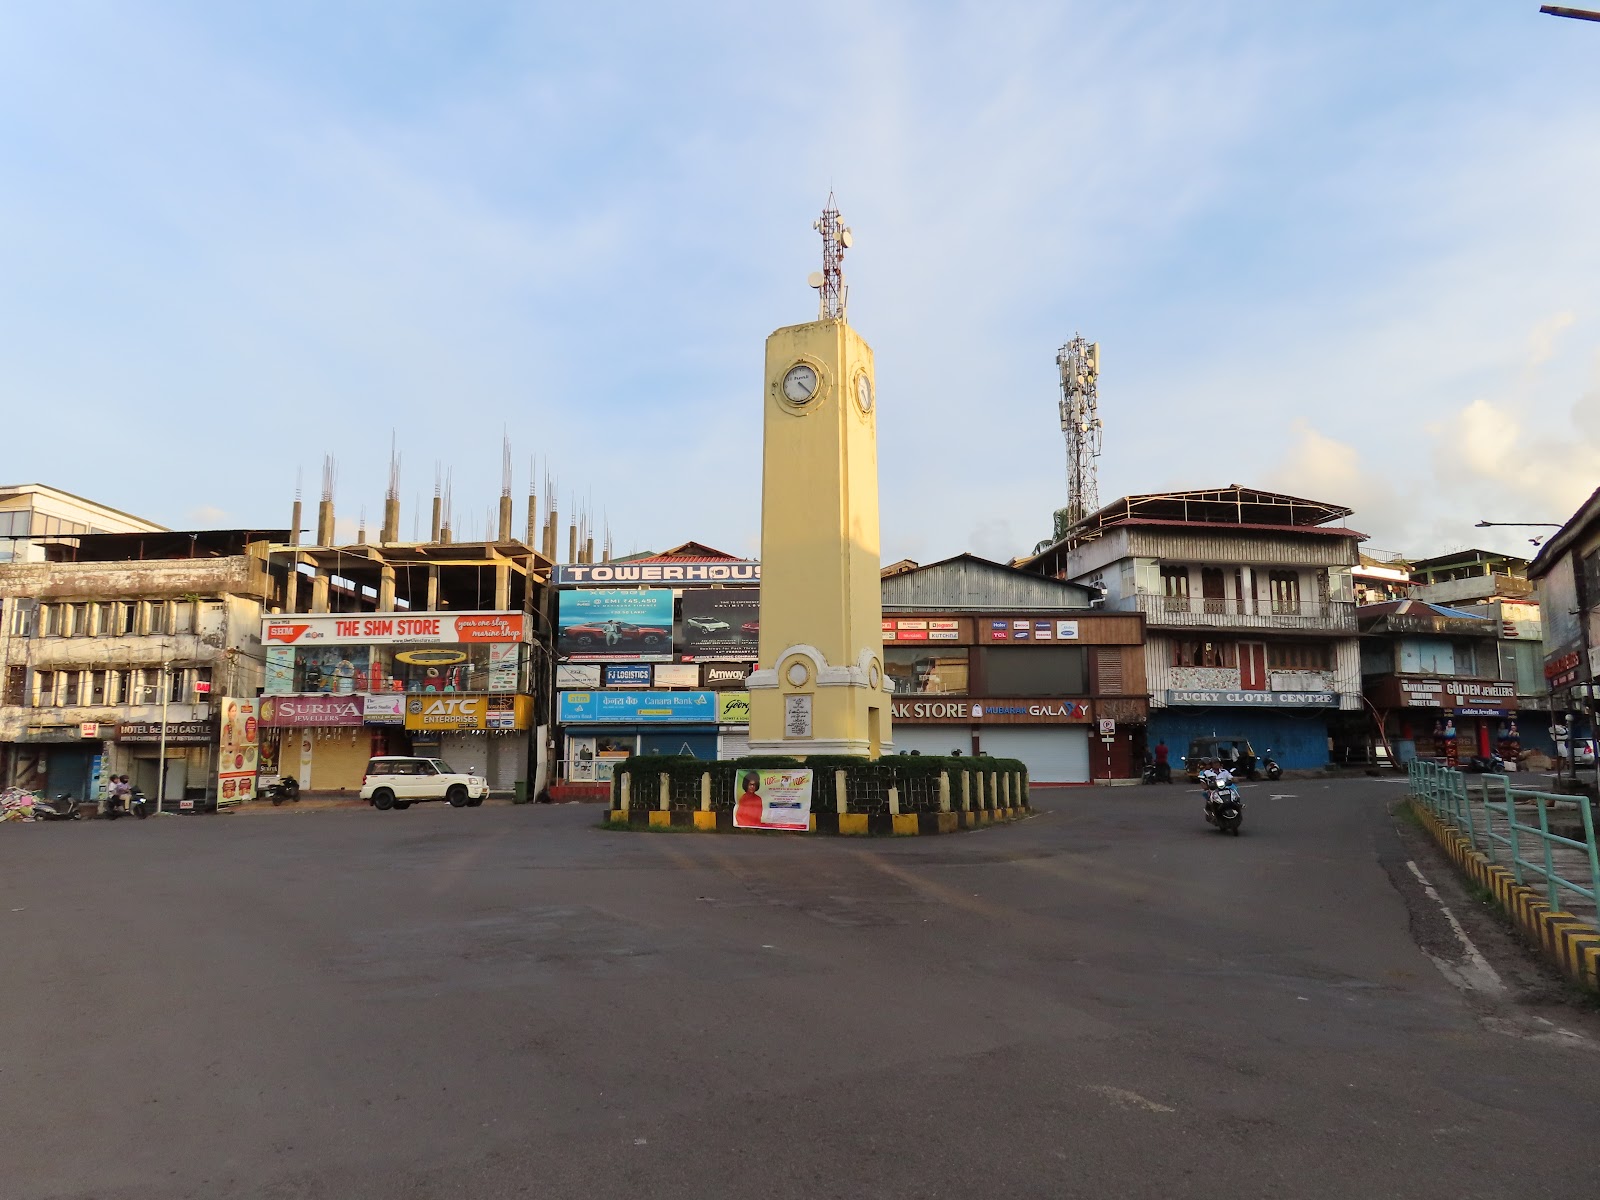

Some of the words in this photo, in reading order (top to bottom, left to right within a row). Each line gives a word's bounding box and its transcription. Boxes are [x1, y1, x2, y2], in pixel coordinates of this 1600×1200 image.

[336, 620, 360, 636] THE
[364, 620, 393, 636] SHM
[397, 620, 440, 636] STORE
[458, 621, 476, 630] your
[270, 627, 294, 636] SHM
[472, 629, 500, 637] marine
[501, 626, 521, 640] shop
[708, 669, 744, 680] Amway
[1446, 684, 1480, 696] GOLDEN
[1482, 686, 1514, 696] JEWELLERS
[644, 696, 672, 704] Canara
[674, 696, 692, 704] Bank
[1174, 692, 1220, 701] LUCKY
[1226, 694, 1272, 702] CLOTH
[1279, 694, 1332, 702] CENTRE
[279, 702, 364, 716] SURIYA
[424, 700, 480, 714] ATC
[914, 703, 968, 718] STORE
[1029, 702, 1089, 718] GALAXY
[424, 716, 478, 724] ENTERPRISES
[121, 726, 148, 734] HOTEL
[150, 726, 178, 734] BECH
[180, 726, 210, 734] CASTLE
